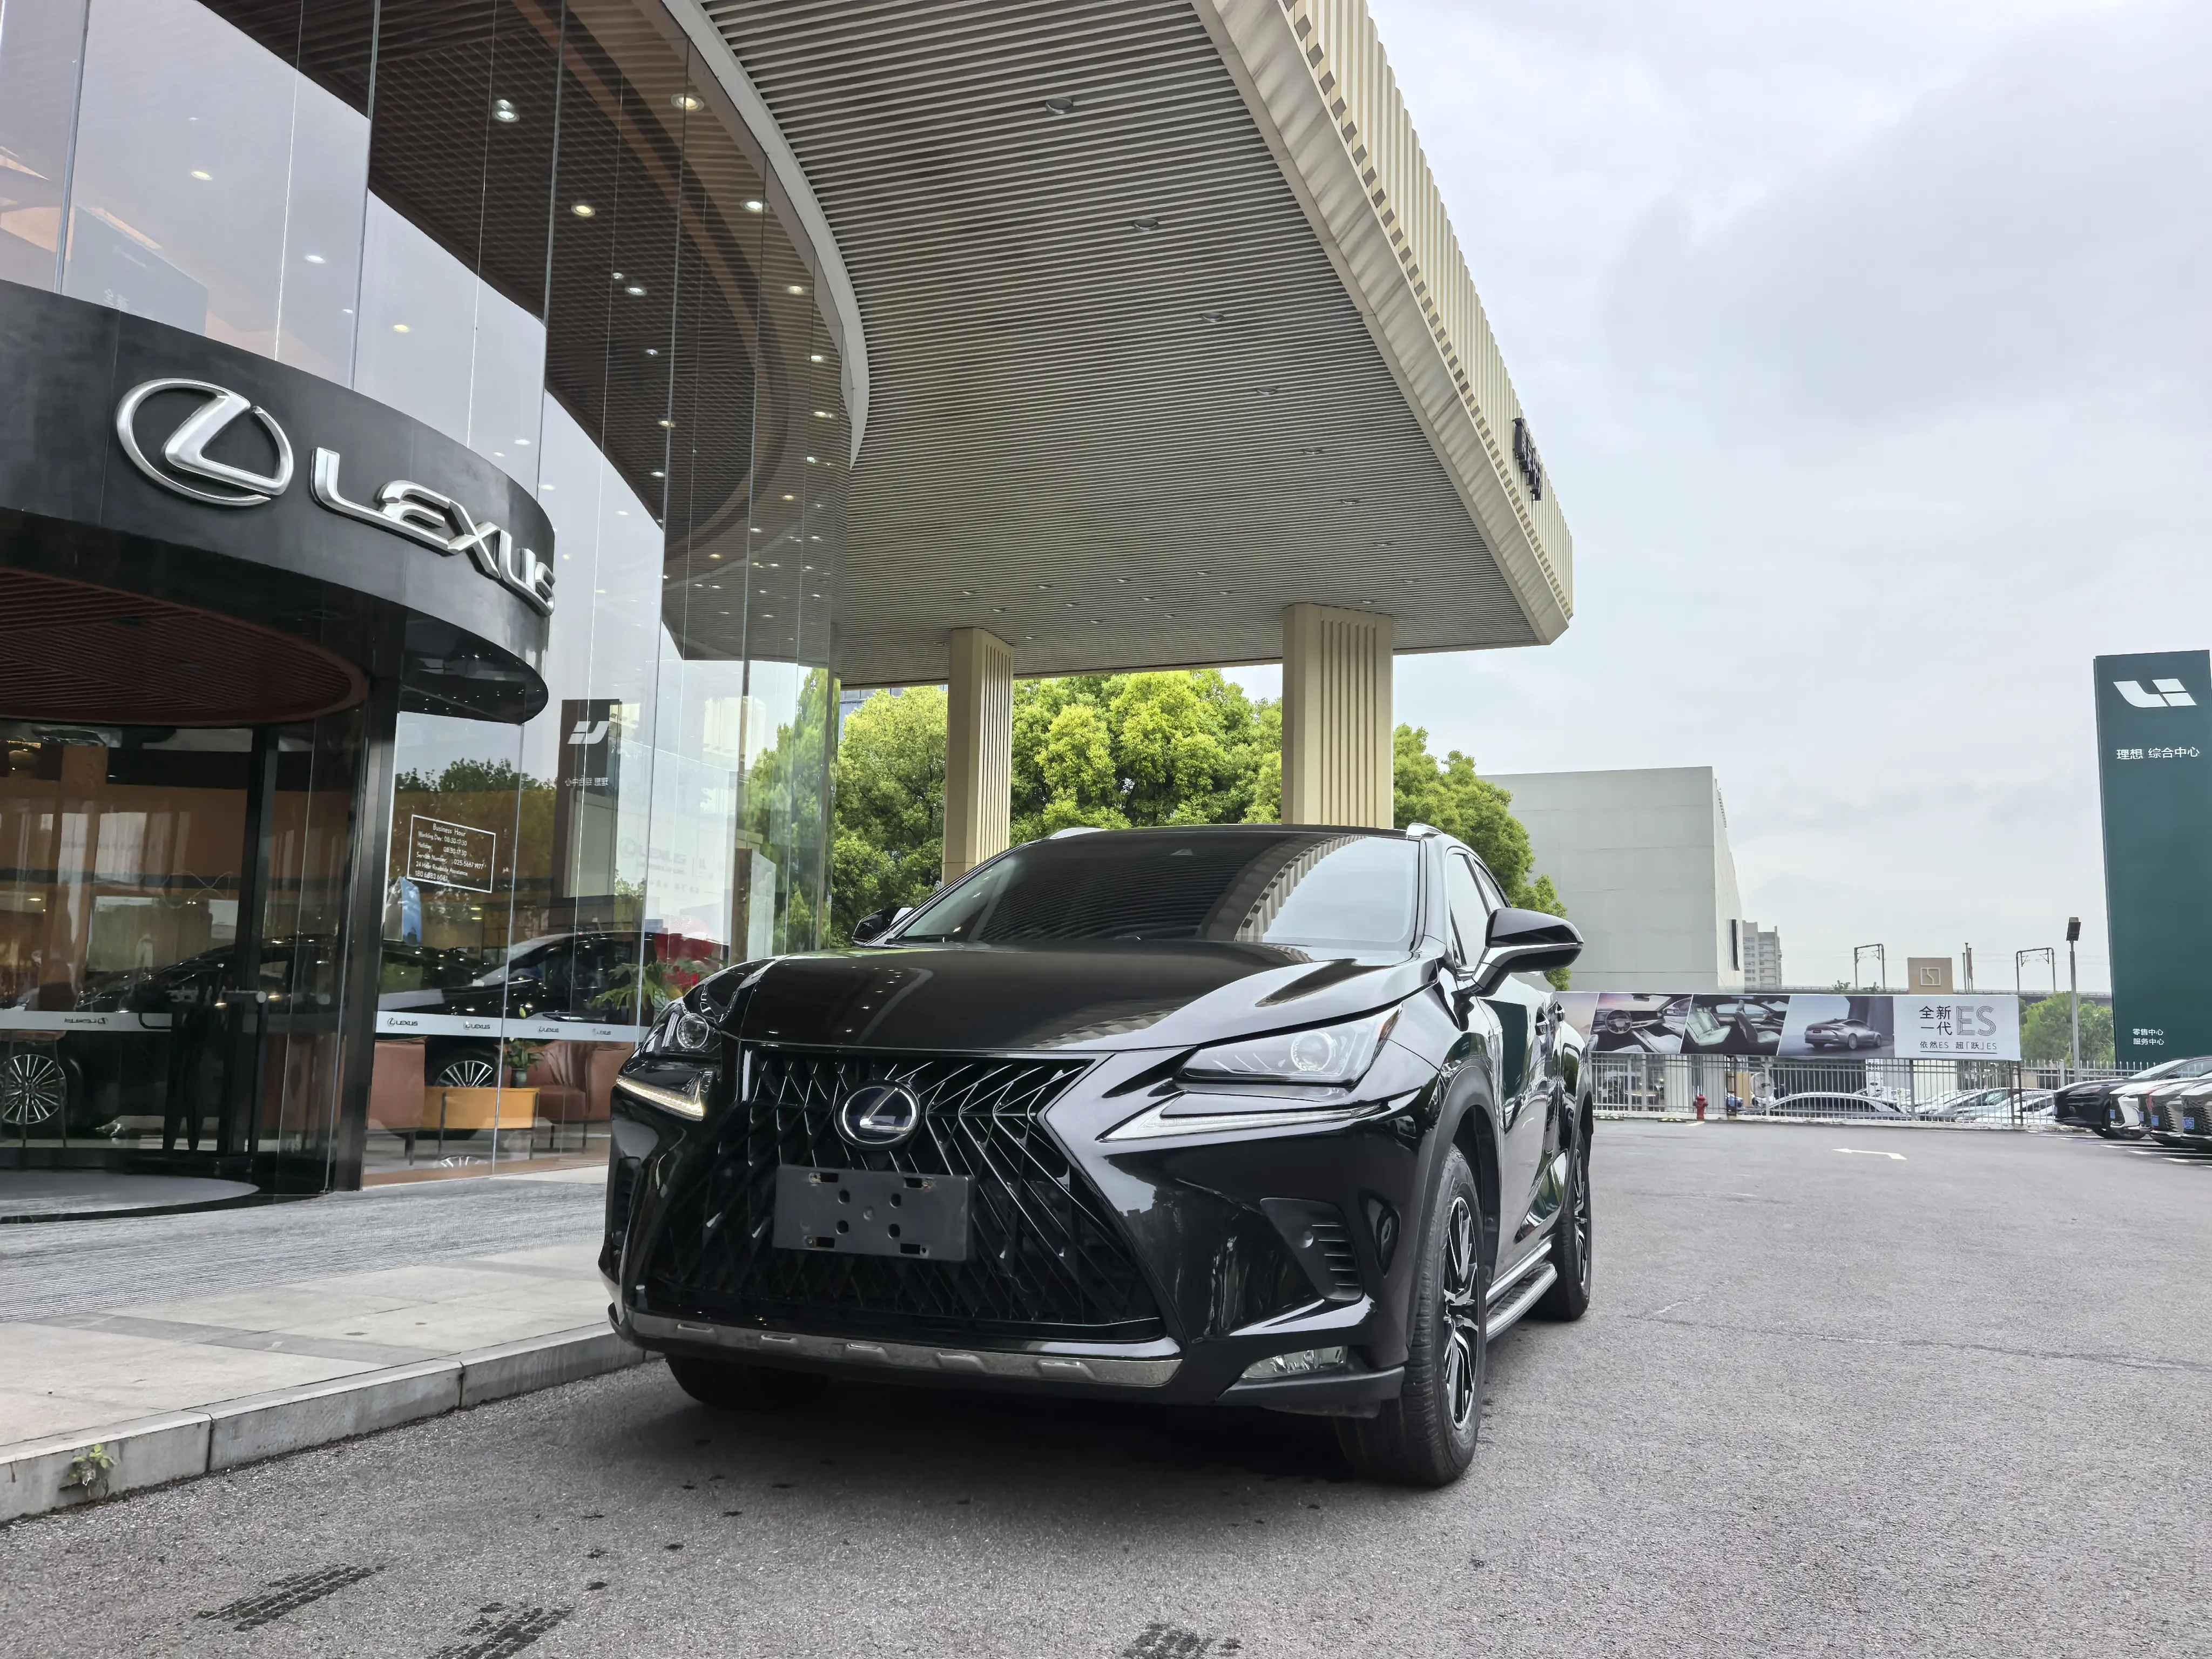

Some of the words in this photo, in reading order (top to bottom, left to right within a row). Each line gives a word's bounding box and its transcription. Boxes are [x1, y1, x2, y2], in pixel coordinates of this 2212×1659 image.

[311, 447, 556, 617] LEXUS
[2116, 748, 2143, 760] 理想
[2148, 746, 2200, 759] 综合中心
[454, 828, 466, 837] Hour
[1919, 1006, 1951, 1020] 全新
[1920, 1021, 1952, 1035] 一代
[1956, 1006, 1996, 1036] ES
[1920, 1040, 1949, 1049] 依然ES
